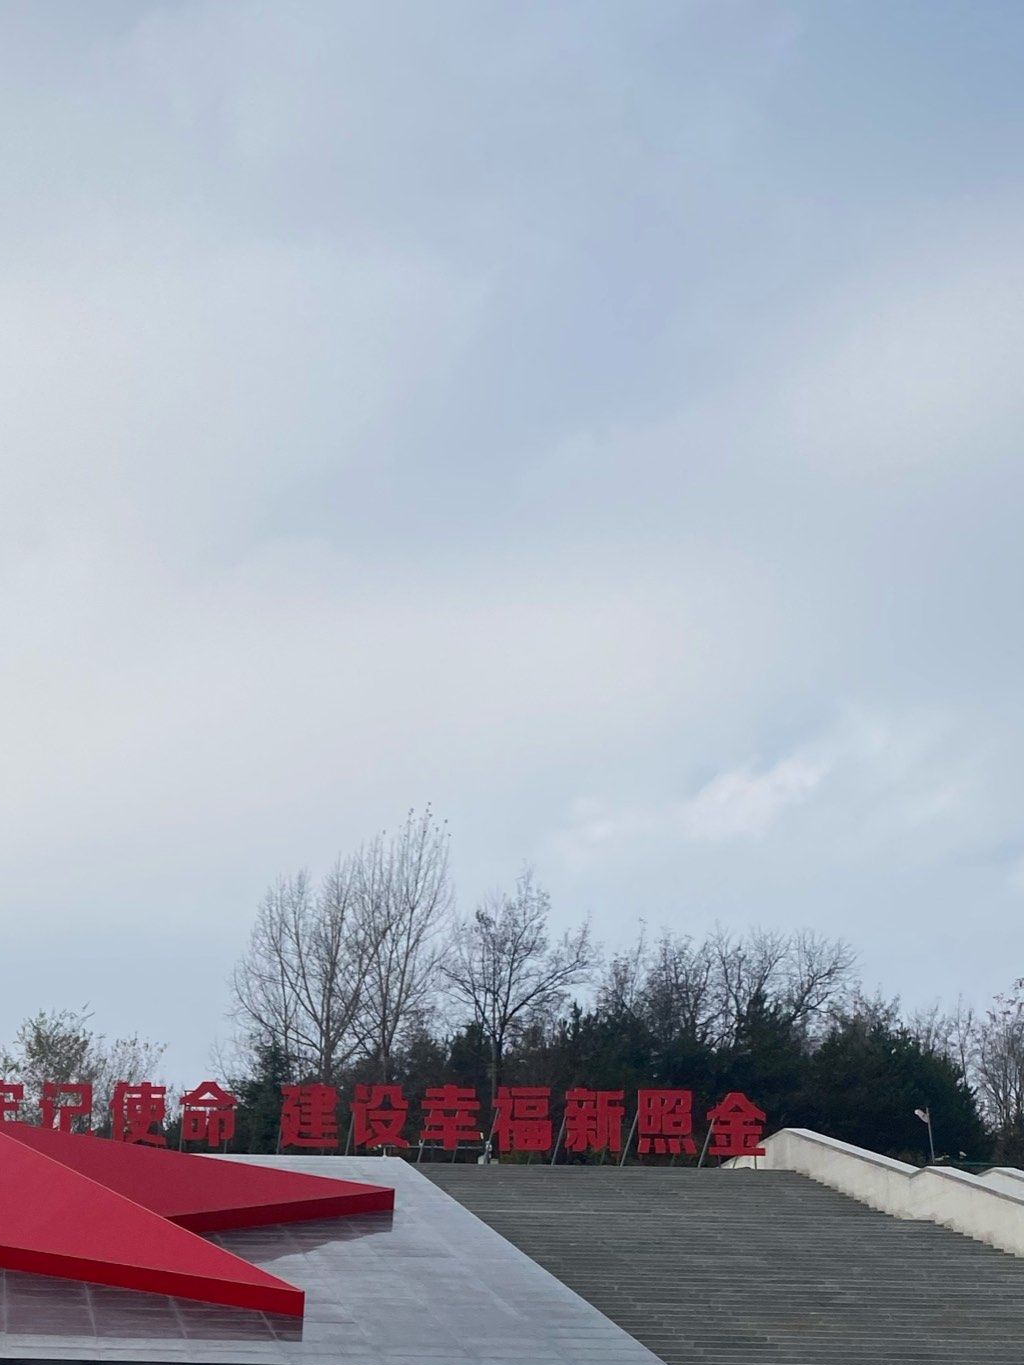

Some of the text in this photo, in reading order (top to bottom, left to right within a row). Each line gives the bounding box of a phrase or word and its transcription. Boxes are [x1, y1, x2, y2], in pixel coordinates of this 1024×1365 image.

[280, 1083, 767, 1156] 建设幸福新照金
